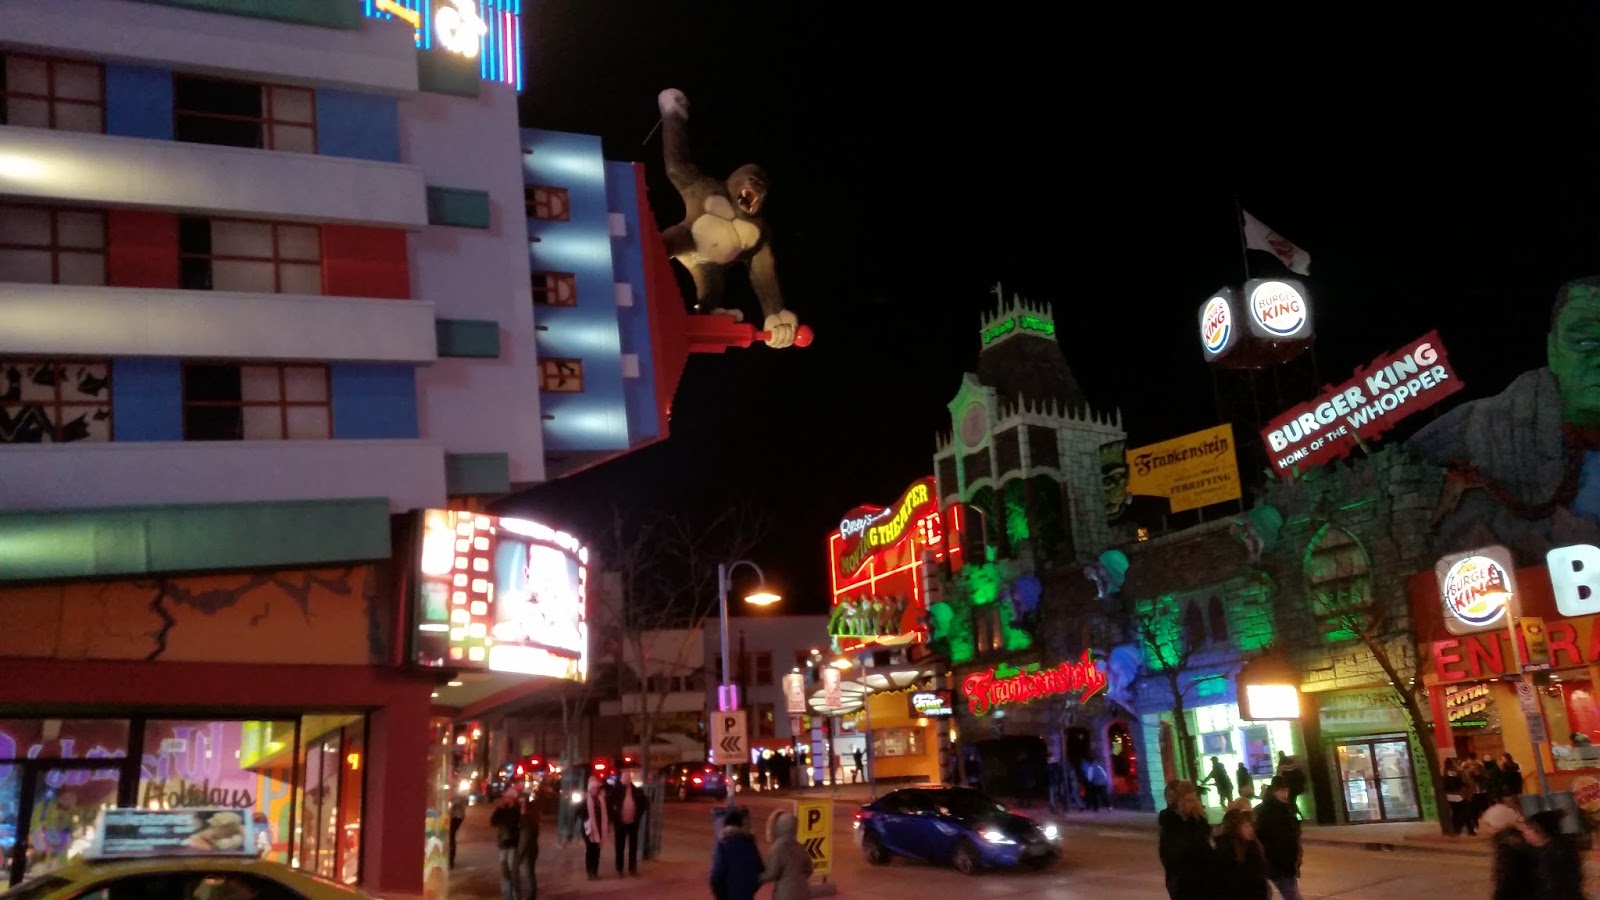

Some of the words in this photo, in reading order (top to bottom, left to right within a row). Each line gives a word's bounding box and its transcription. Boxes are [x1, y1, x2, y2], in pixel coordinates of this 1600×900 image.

[1262, 300, 1300, 322] KING
[1205, 310, 1225, 342] KING
[1268, 386, 1367, 453] BURGER
[1365, 343, 1438, 396] KING
[1278, 447, 1310, 469] HOME
[1311, 436, 1325, 452] OF
[1326, 425, 1347, 442] THE
[1347, 365, 1449, 429] WHOPPER
[1134, 434, 1228, 477] Frankenstein
[1169, 473, 1231, 494] TERRIFYING
[878, 484, 928, 545] THEATER
[1446, 698, 1487, 721] CAVES
[724, 717, 736, 733] P
[807, 809, 821, 831] P
